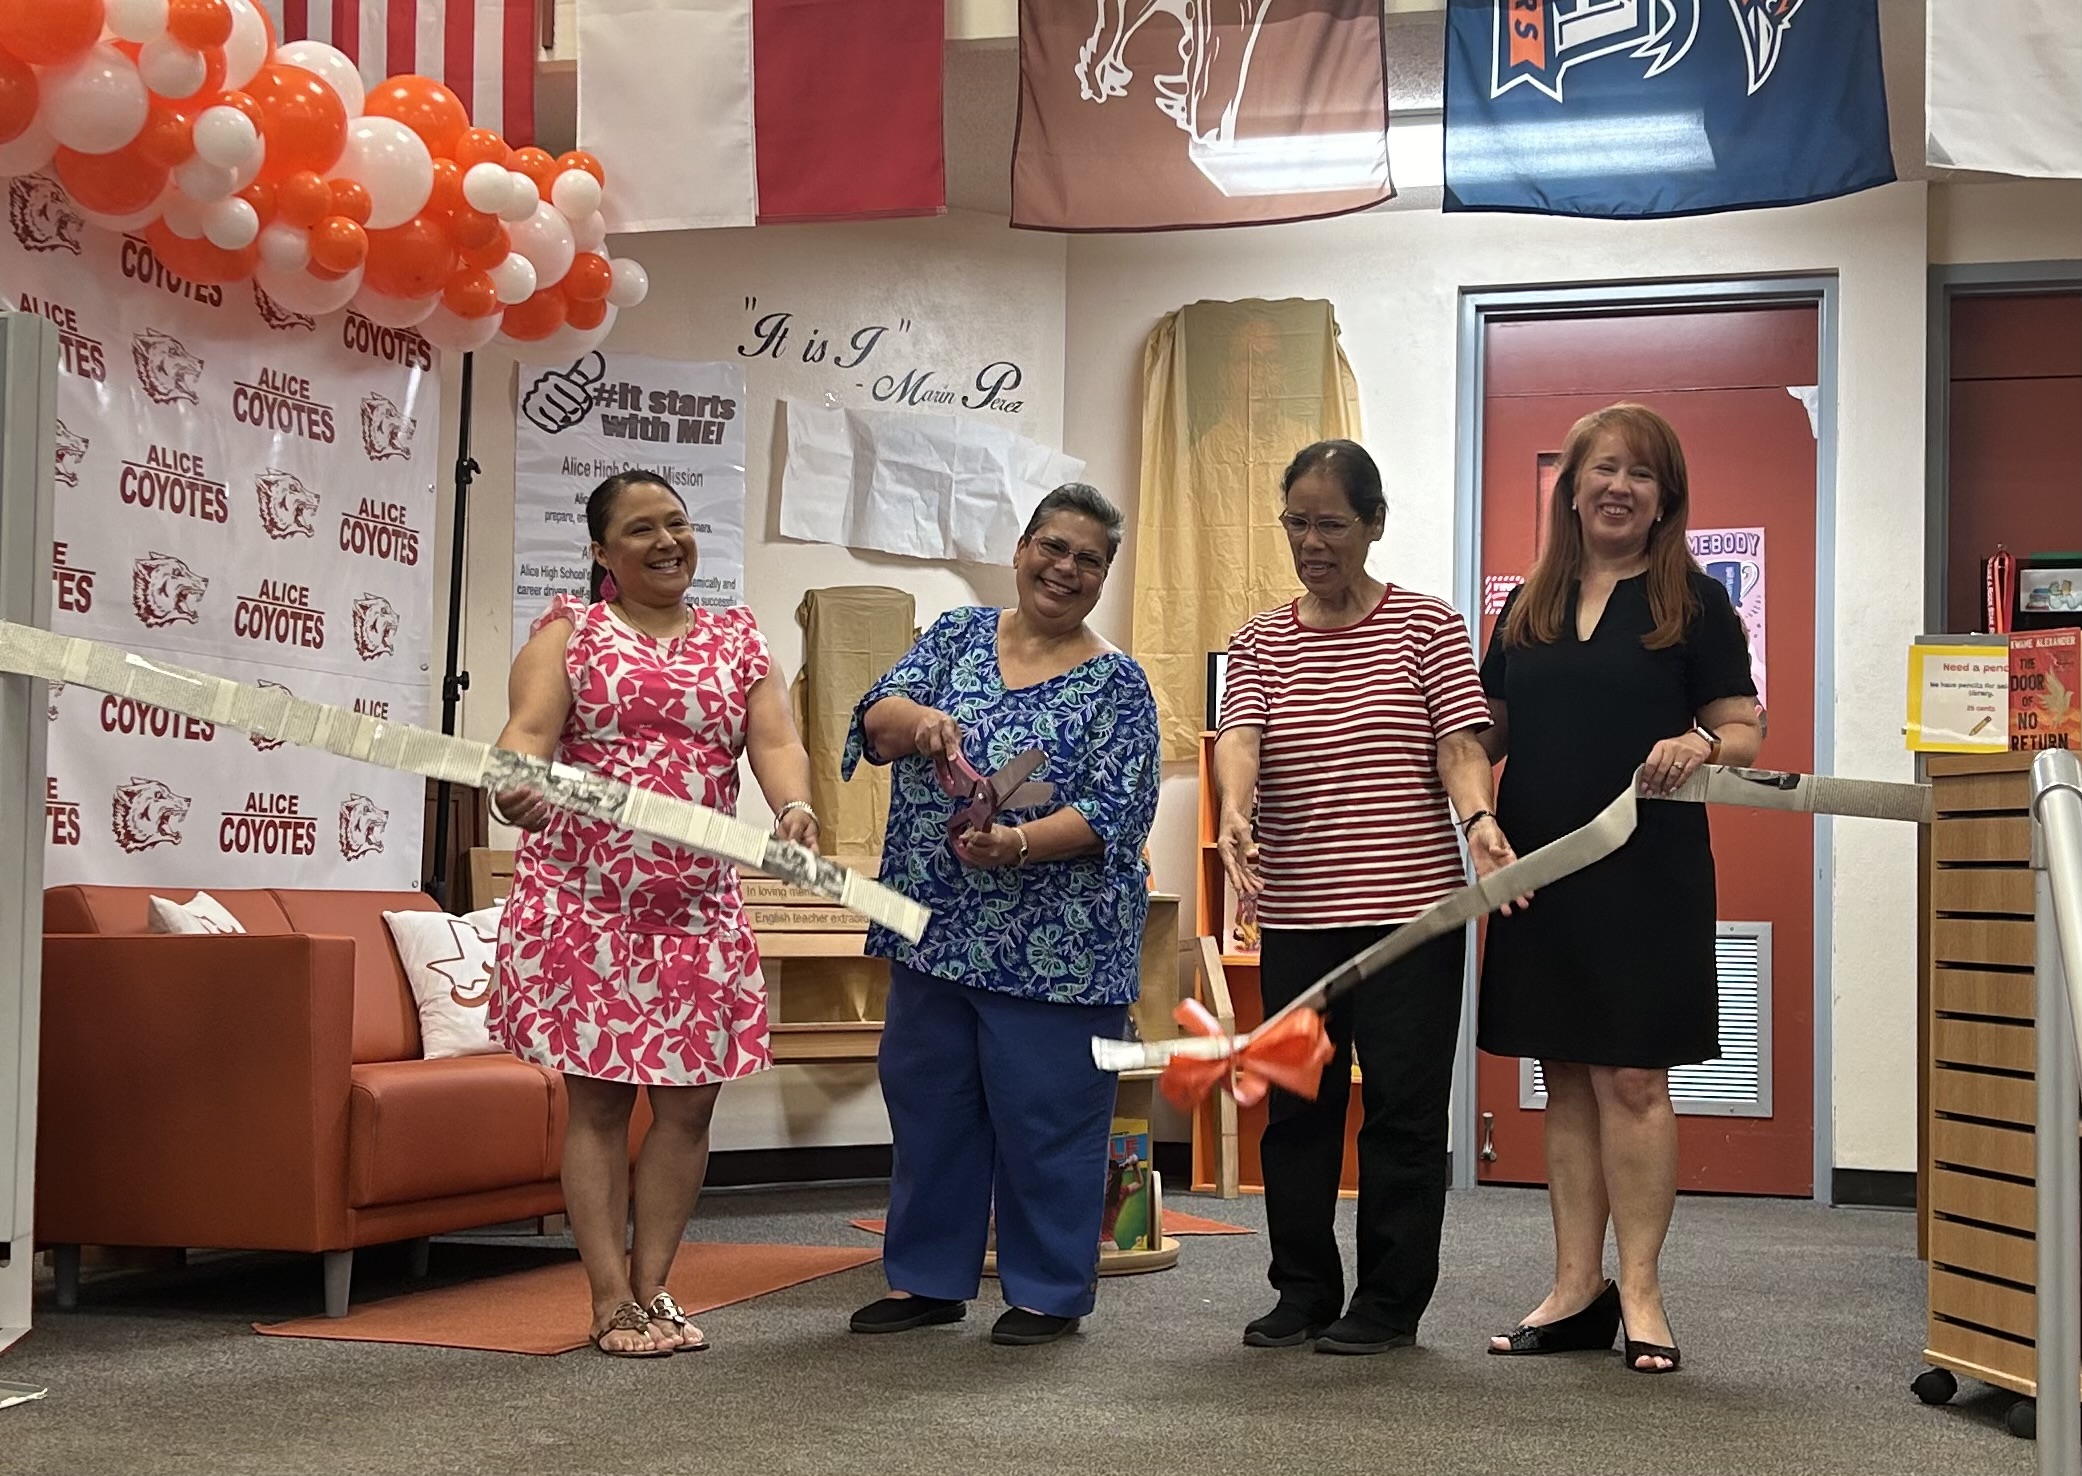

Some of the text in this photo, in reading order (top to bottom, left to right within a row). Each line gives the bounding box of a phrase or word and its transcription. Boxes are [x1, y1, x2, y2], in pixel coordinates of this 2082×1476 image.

[343, 315, 432, 372] COYOTES
[801, 329, 829, 363] is
[258, 367, 311, 400] ALICE
[871, 368, 956, 407] Marin
[961, 361, 1024, 413] Perez
[232, 387, 335, 444] COYOTES
[592, 382, 737, 421] #It starts
[600, 413, 726, 446] with ME!
[146, 445, 204, 477] ALICE
[561, 456, 592, 478] Alice
[662, 466, 704, 488] Mission
[120, 466, 229, 524] COYOTES
[359, 497, 407, 525] ALICE
[339, 518, 419, 566] COYOTES
[541, 565, 559, 582] High
[259, 578, 310, 607] ALICE
[516, 584, 543, 596] career
[234, 601, 325, 650] COYOTES
[1943, 663, 1970, 672] Need
[2019, 657, 2036, 670] THE
[2009, 674, 2045, 691] DOOR
[2021, 695, 2034, 707] OF
[2017, 711, 2038, 730] NO
[245, 792, 299, 815] ALICE
[219, 817, 317, 856] COYOTES
[746, 885, 757, 896] In
[758, 884, 788, 898] loving
[754, 911, 791, 925] English
[792, 911, 829, 924] teacher
